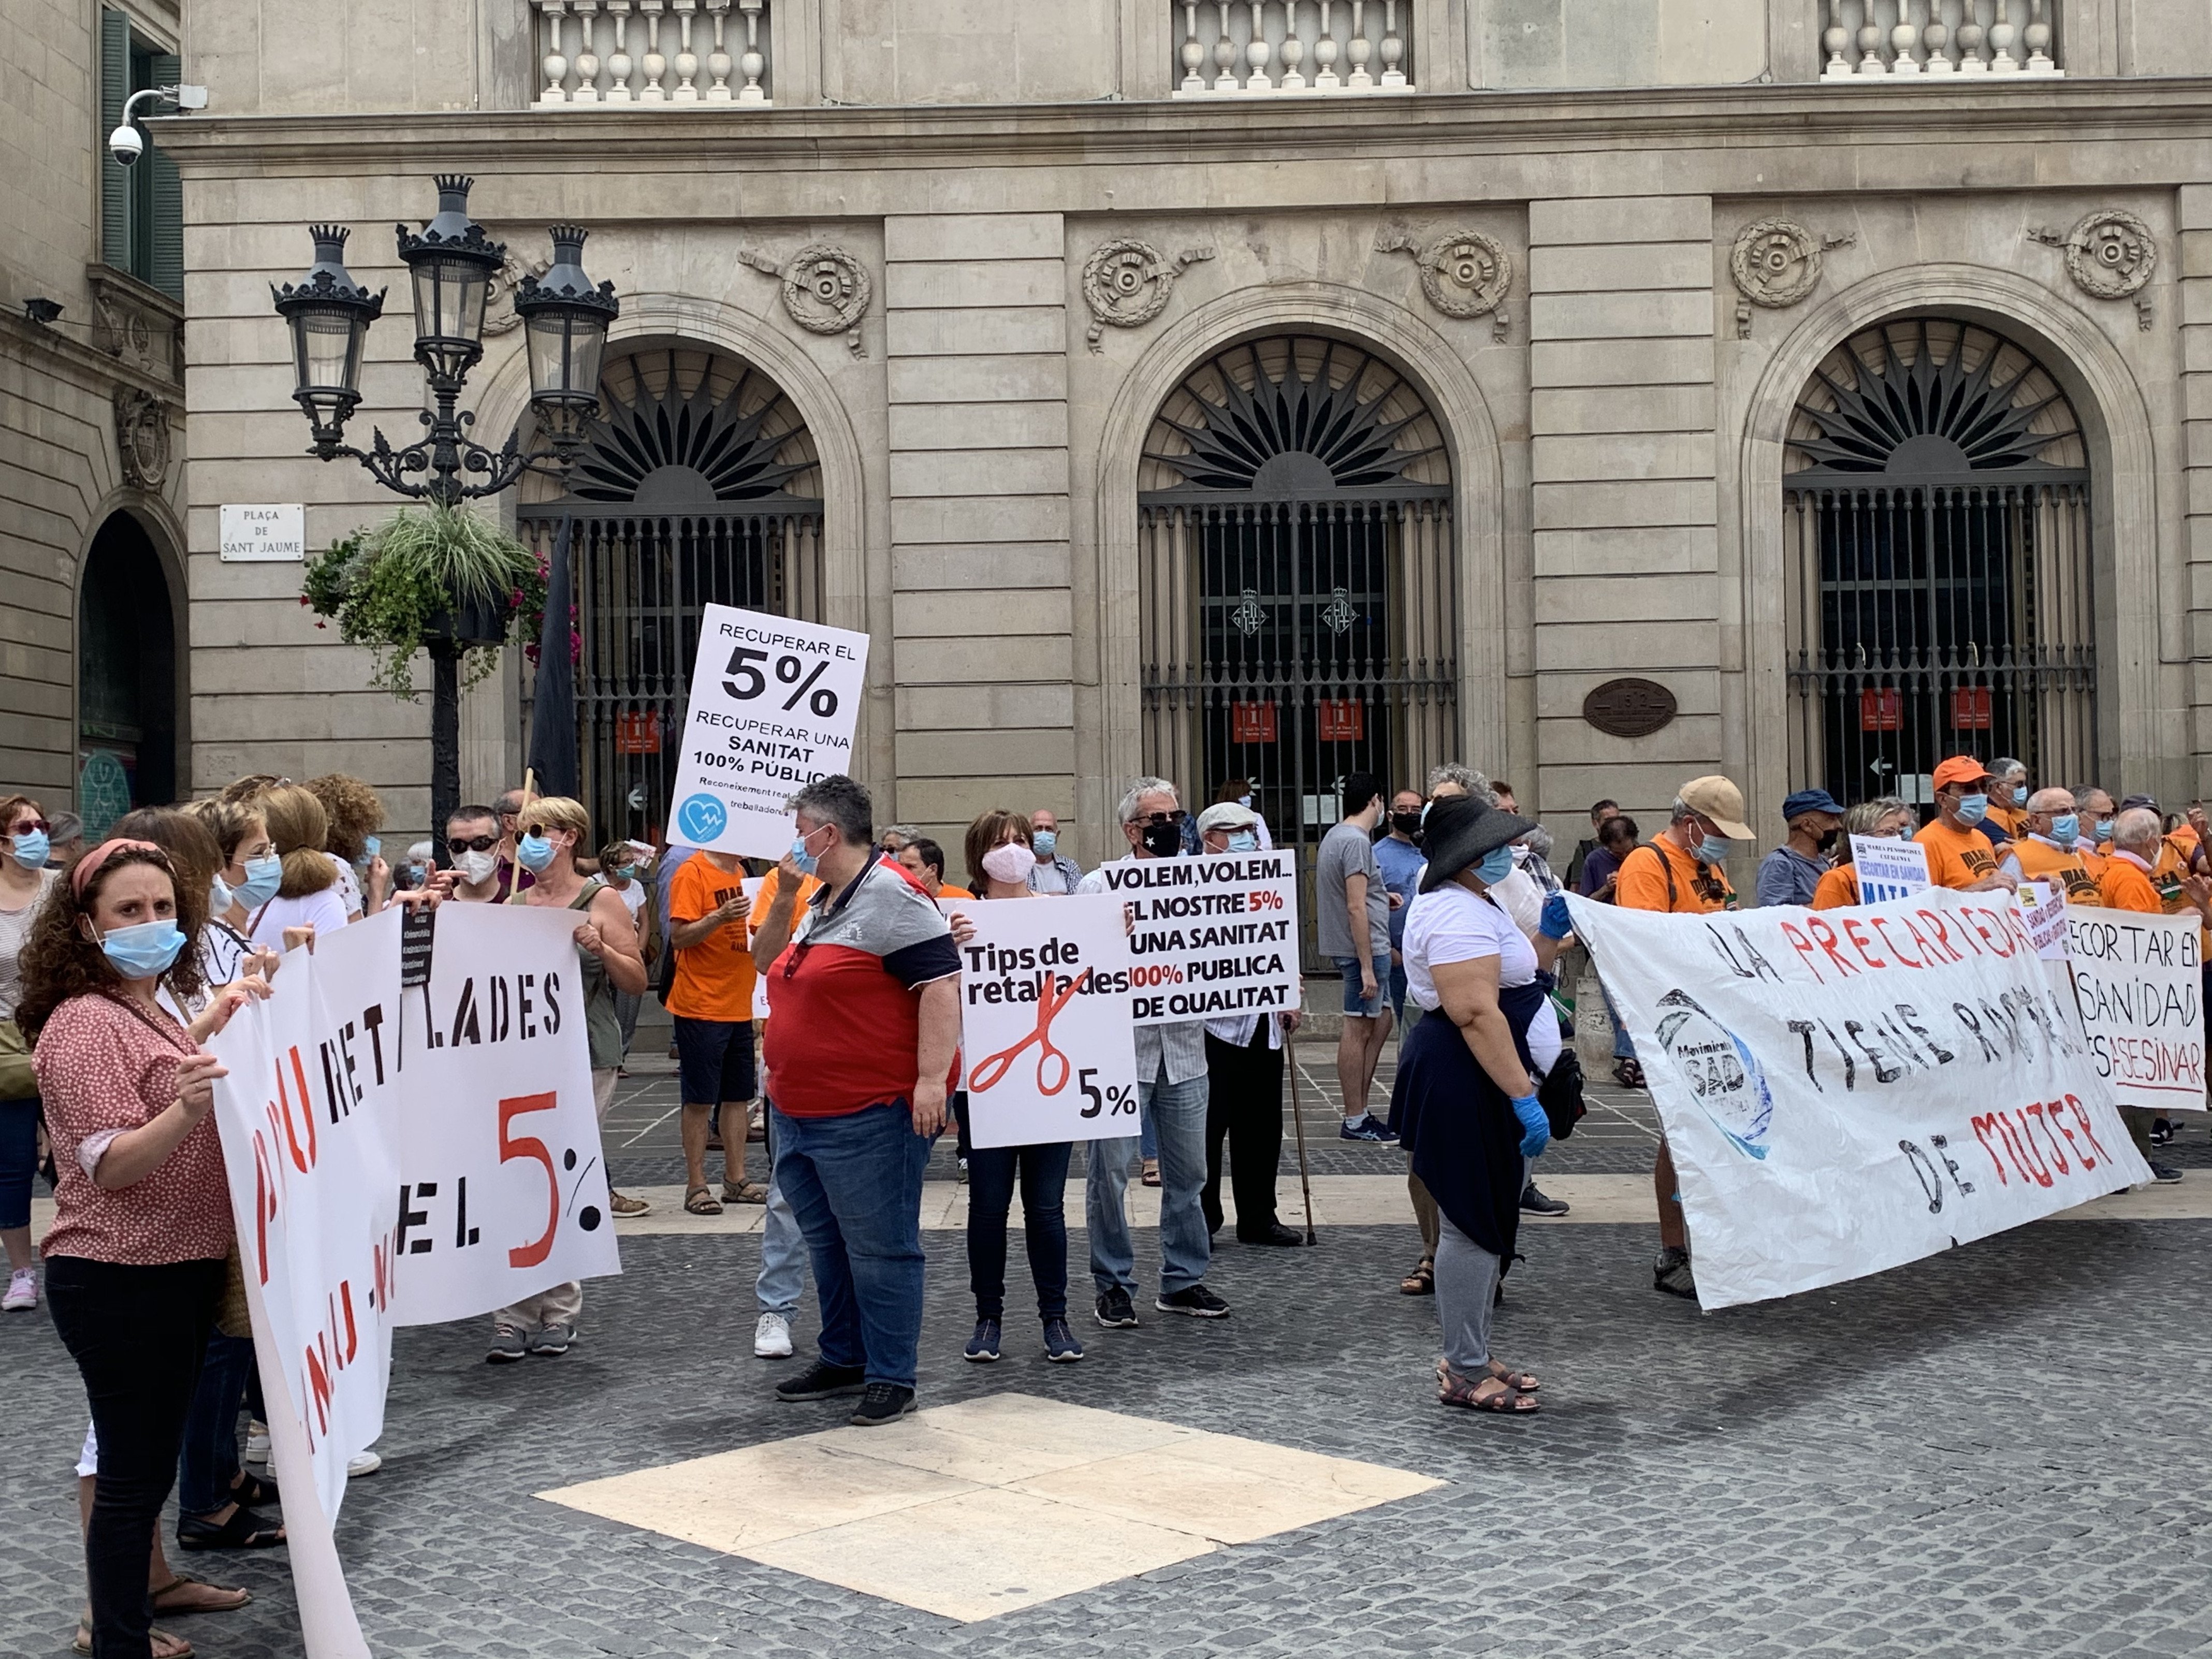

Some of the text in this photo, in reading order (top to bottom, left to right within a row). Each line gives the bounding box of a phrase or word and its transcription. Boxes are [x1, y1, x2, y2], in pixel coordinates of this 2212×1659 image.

[244, 511, 279, 521] PLAÇA
[255, 527, 268, 535] DE
[223, 542, 300, 553] SANT JAUME
[719, 623, 856, 660] RECUPERAR EL
[721, 646, 838, 718] 5%
[696, 710, 850, 749] RECUPERAR UNA
[728, 736, 814, 763] SANITAT
[694, 751, 827, 785] 100% PÚBLIC
[700, 777, 771, 796] Reconeixement
[1859, 860, 1926, 882] RECORTAR EN SANIDAD
[1152, 893, 1245, 920] NOSTRE
[1248, 890, 1283, 912] 5%
[1862, 881, 1909, 905] MATA
[965, 937, 1079, 973] Tips de
[1130, 920, 1289, 955] UNA SANITAT
[1705, 906, 2039, 985] LA PRECARIEDA
[2069, 920, 2174, 967] ECORTAR
[968, 966, 1129, 1005] retallades
[1186, 953, 1285, 983] PUBLICA
[1132, 984, 1289, 1019] DE QUALITAT
[1787, 1003, 1955, 1093] TIENE
[1079, 1067, 1137, 1118] 5%
[1684, 1053, 1744, 1097] SAD
[1898, 1093, 2113, 1214] DE MUJER
[397, 1090, 602, 1269] EL 5%
